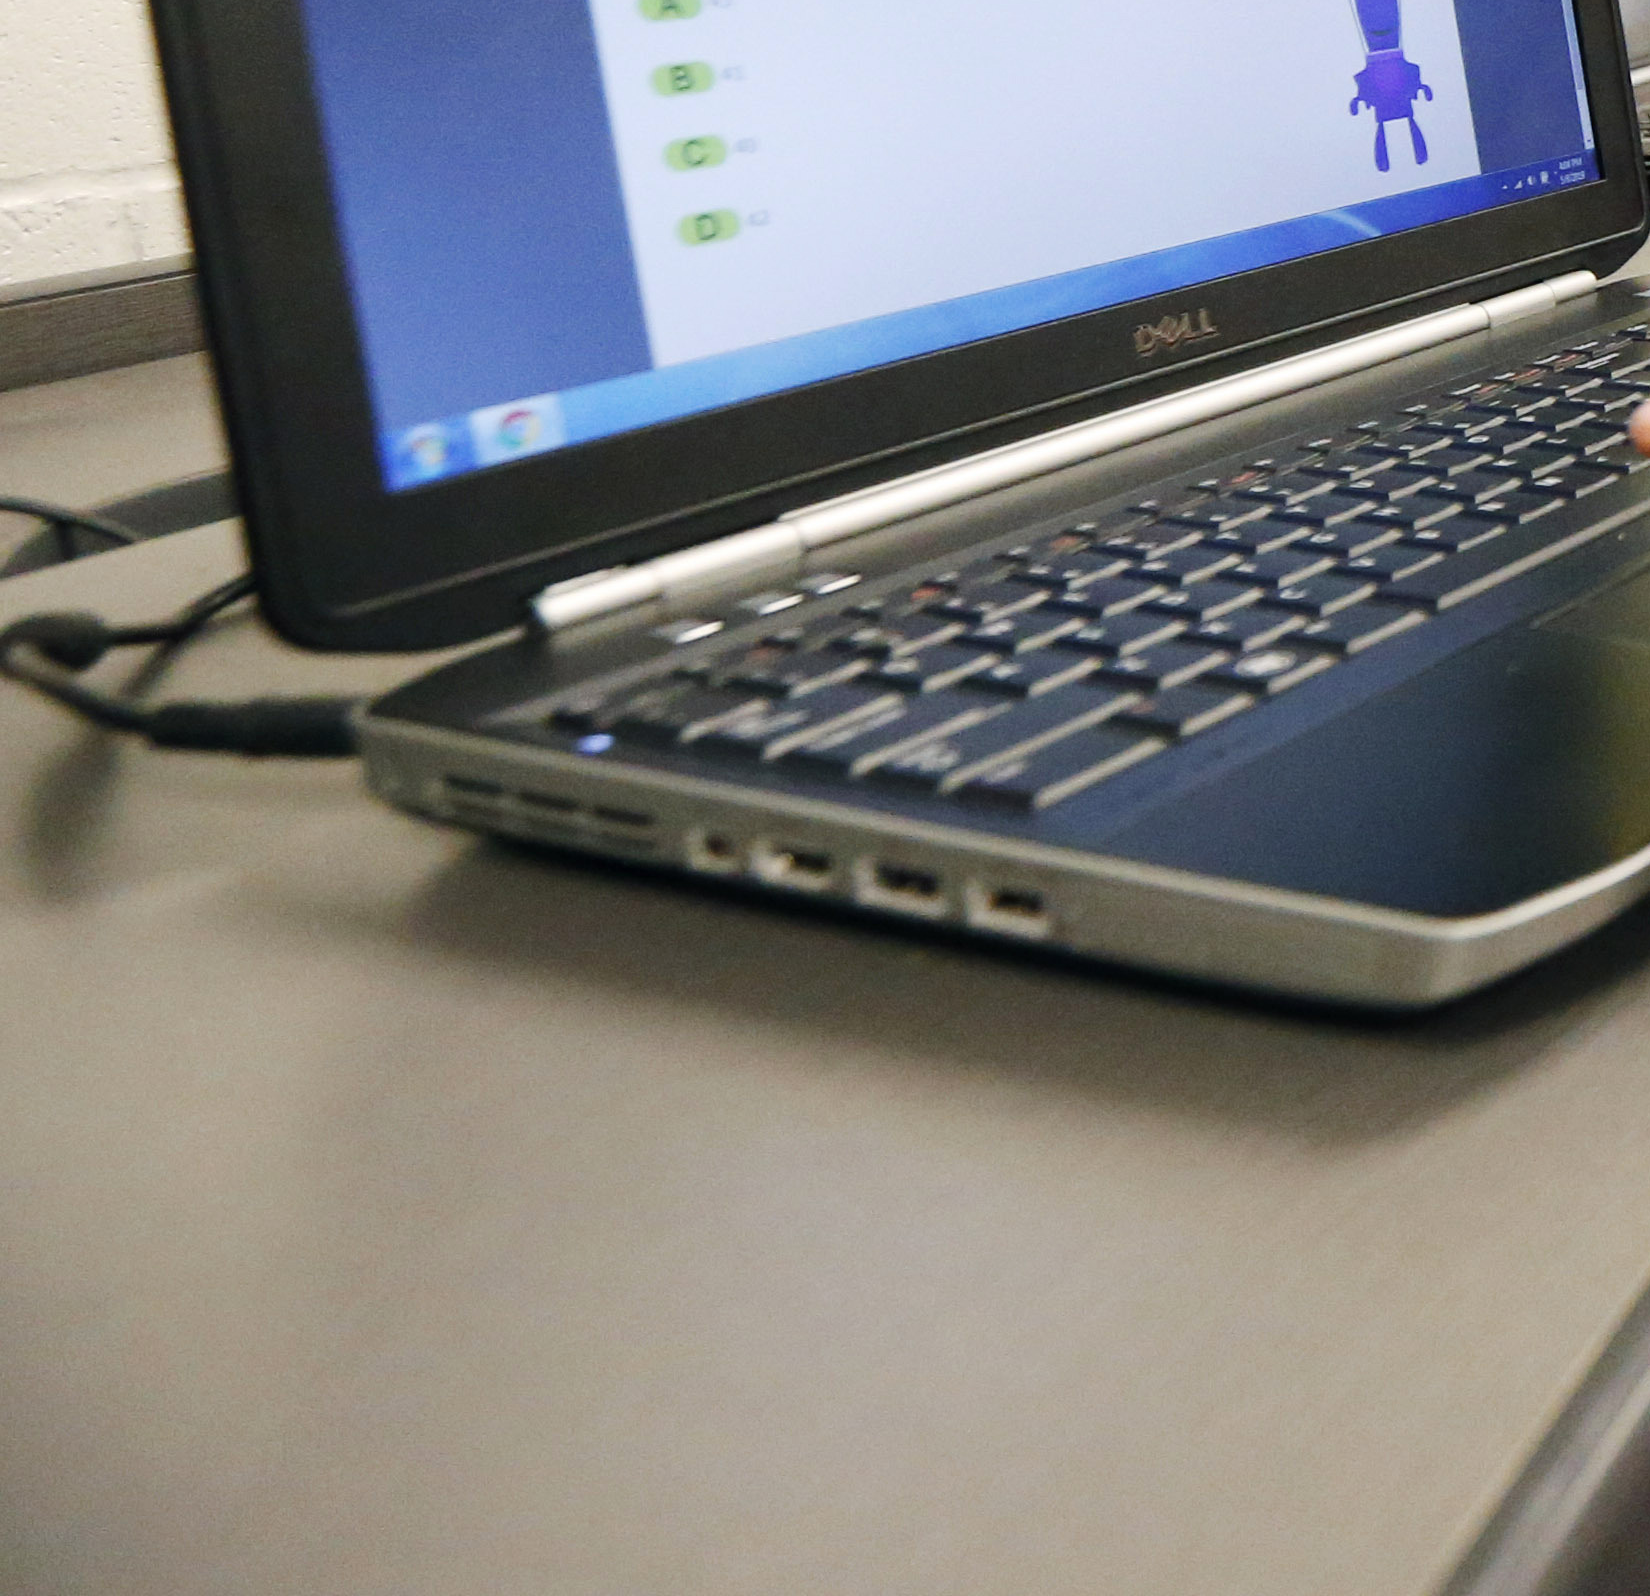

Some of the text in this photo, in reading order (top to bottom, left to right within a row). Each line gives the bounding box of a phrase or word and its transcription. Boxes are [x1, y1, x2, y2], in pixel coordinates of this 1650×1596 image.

[669, 64, 694, 92] B
[682, 138, 707, 167] C
[694, 212, 721, 241] D
[1133, 307, 1219, 357] DELL
